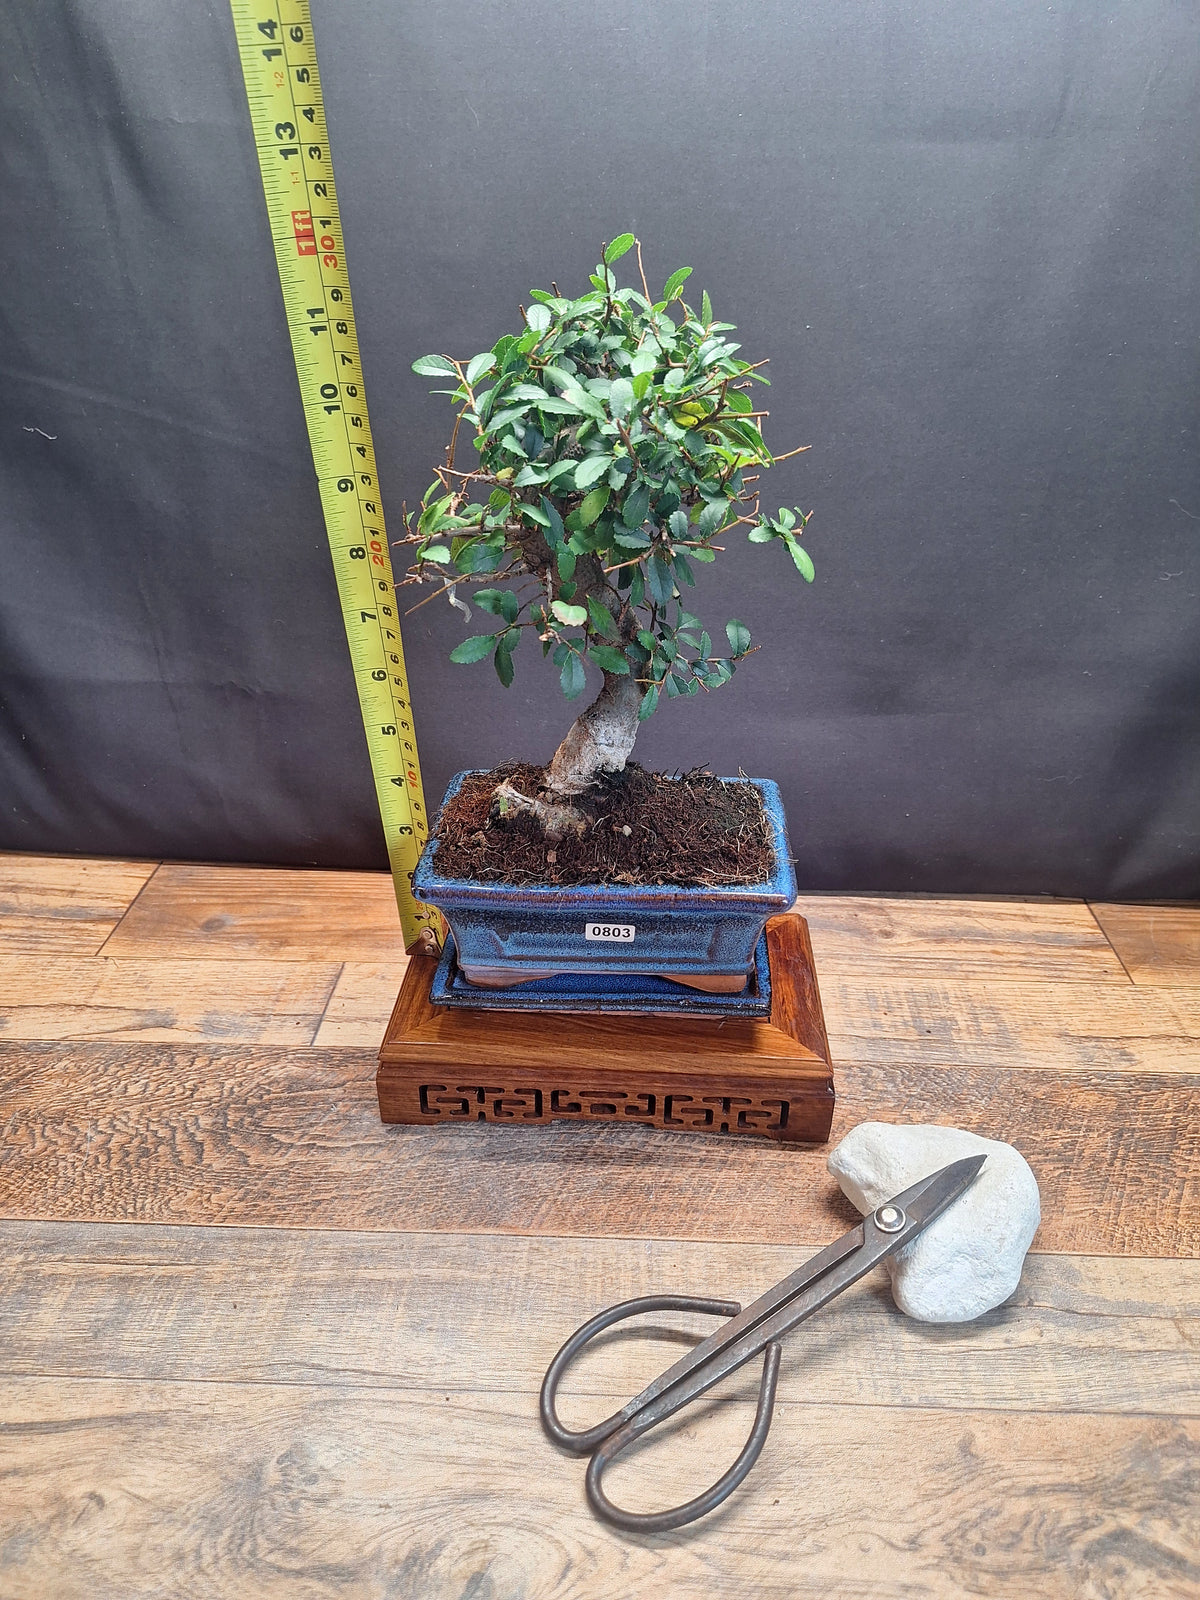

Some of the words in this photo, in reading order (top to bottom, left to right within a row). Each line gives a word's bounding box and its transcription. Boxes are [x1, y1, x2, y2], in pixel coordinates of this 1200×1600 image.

[290, 26, 304, 42] 6
[257, 19, 282, 62] 14
[296, 68, 310, 84] 5
[302, 107, 315, 122] 4
[275, 122, 298, 160] 13
[308, 146, 322, 160] 3
[314, 183, 328, 198] 2
[320, 220, 332, 228] 1
[320, 235, 338, 268] 30
[330, 288, 343, 302] 9
[306, 308, 328, 336] 11
[336, 322, 348, 334] 8
[340, 354, 353, 366] 7
[346, 385, 358, 398] 6
[320, 384, 340, 415] 10
[351, 416, 362, 428] 5
[356, 446, 366, 458] 4
[337, 478, 354, 492] 9
[361, 474, 372, 486] 3
[365, 502, 376, 514] 2
[350, 546, 366, 560] 8
[370, 540, 384, 568] 20
[378, 581, 388, 592] 9
[360, 611, 377, 623] 7
[382, 606, 392, 617] 8
[386, 630, 396, 640] 7
[390, 654, 400, 664] 6
[372, 670, 387, 682] 6
[394, 677, 403, 688] 5
[398, 699, 406, 709] 4
[382, 725, 396, 736] 5
[401, 720, 410, 730] 3
[404, 742, 413, 752] 2
[390, 776, 404, 787] 4
[408, 770, 418, 788] 10
[399, 826, 413, 835] 3
[592, 926, 630, 938] 0803
